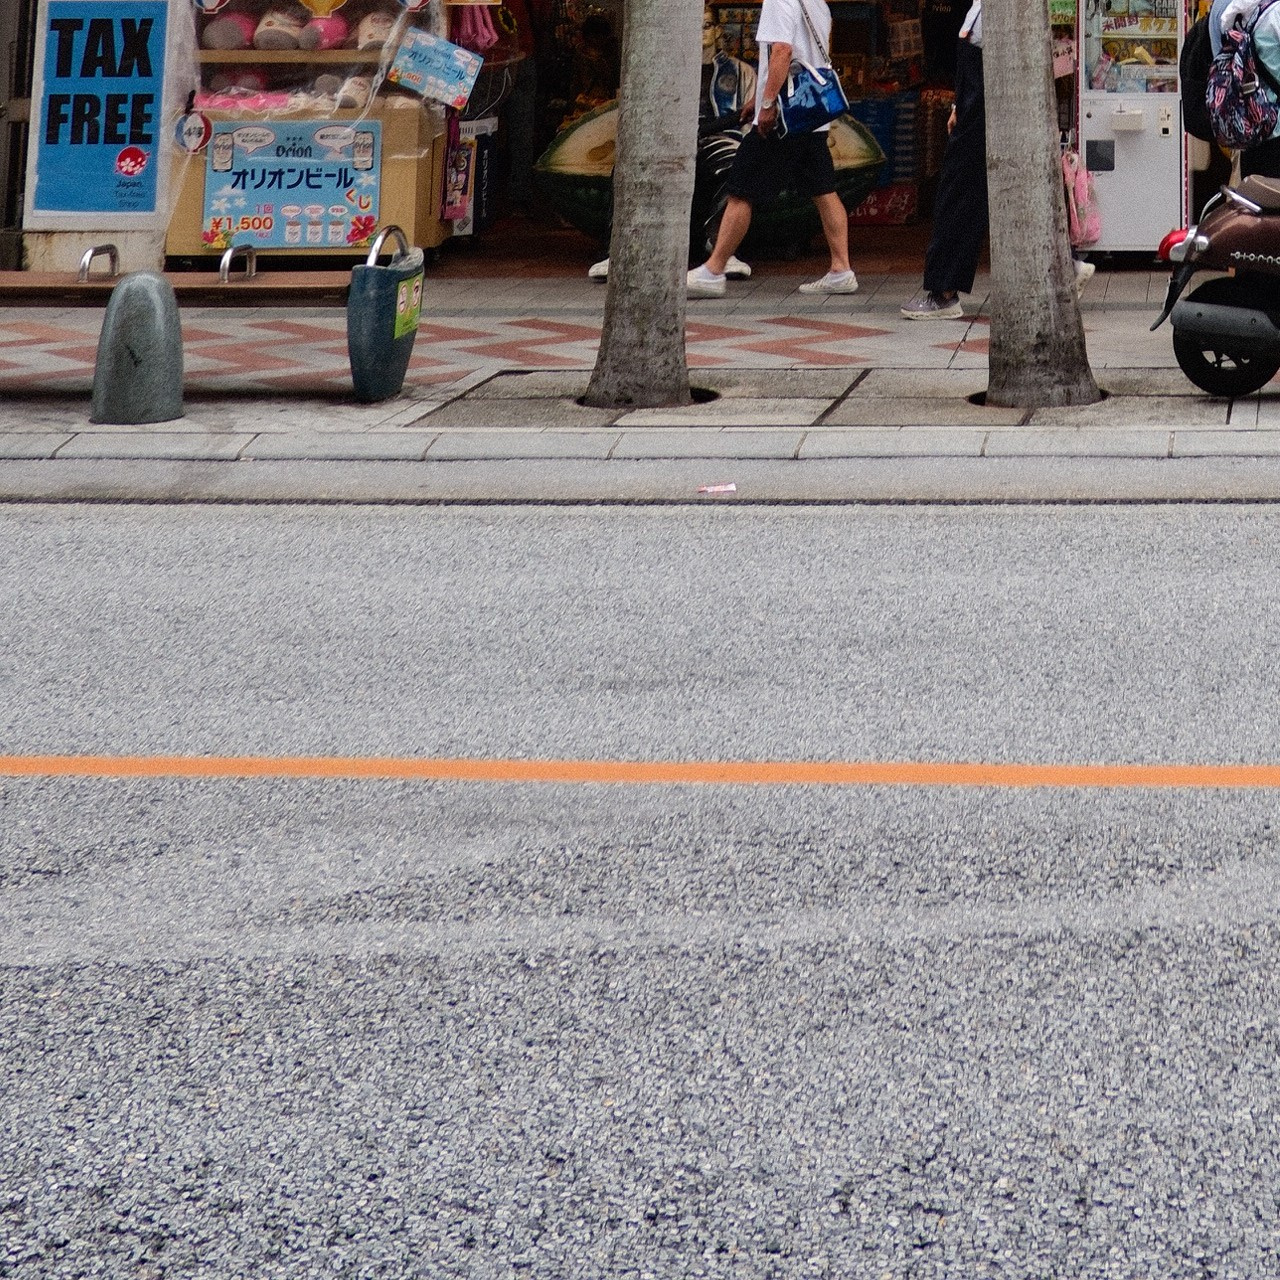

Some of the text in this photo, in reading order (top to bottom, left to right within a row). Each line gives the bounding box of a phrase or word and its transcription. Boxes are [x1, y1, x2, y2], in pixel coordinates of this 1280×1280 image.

[50, 18, 154, 78] TAX
[46, 94, 154, 145] FREE
[276, 142, 312, 158] Orion
[231, 167, 355, 190] オリオンビール
[345, 188, 371, 210] くじ
[211, 216, 274, 231] ¥1,500
